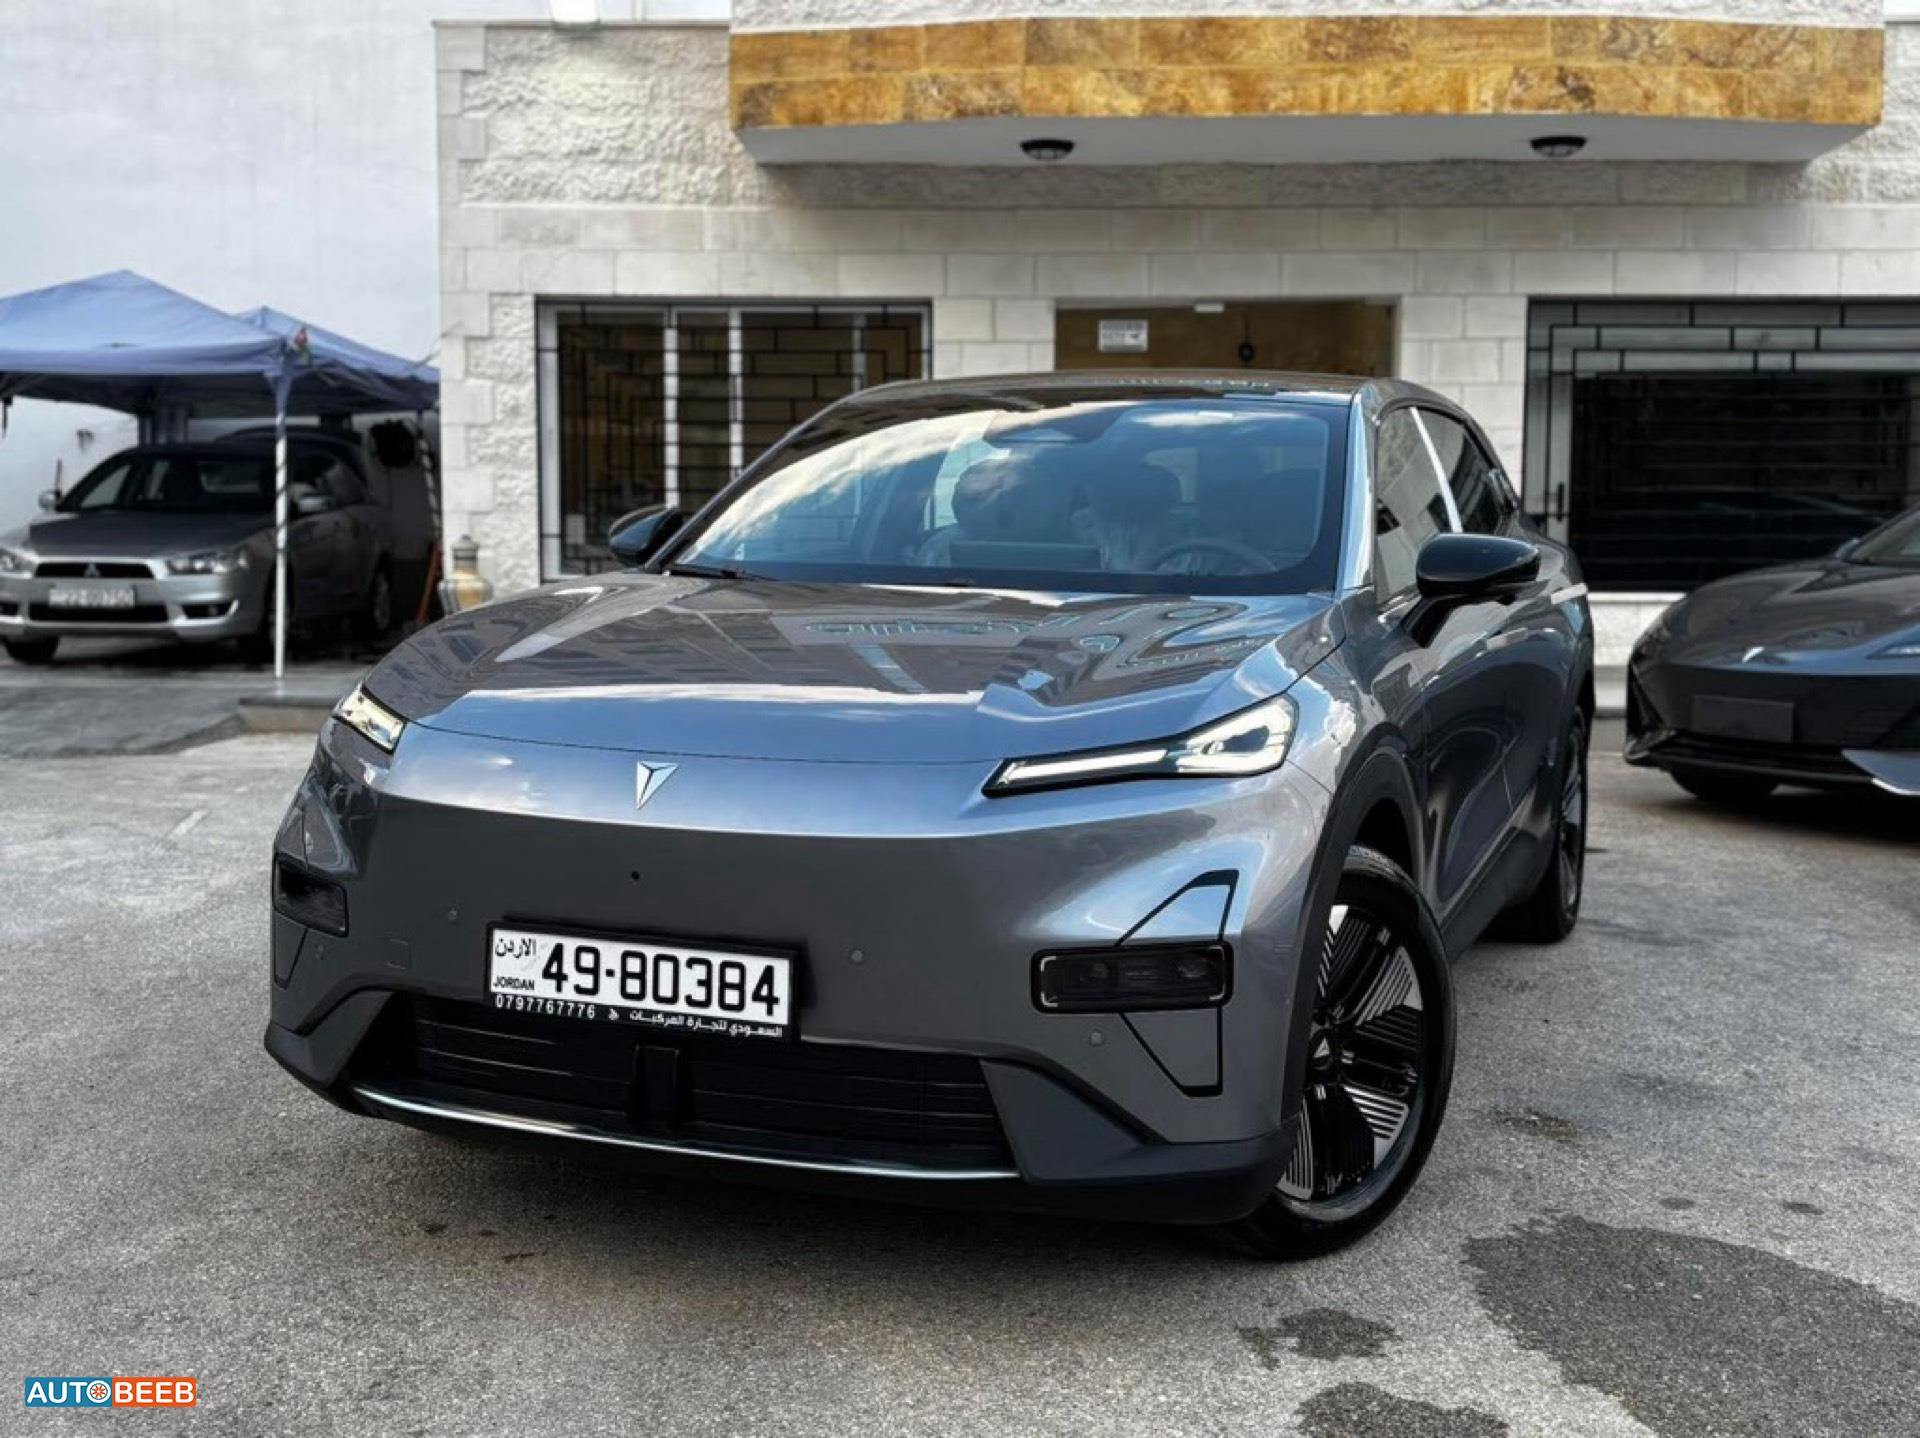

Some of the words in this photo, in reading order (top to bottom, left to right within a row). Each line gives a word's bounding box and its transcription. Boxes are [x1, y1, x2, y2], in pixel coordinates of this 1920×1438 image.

[493, 976, 535, 991] JORDAN
[541, 942, 779, 1016] 49-80384
[496, 993, 596, 1020] 0797767776
